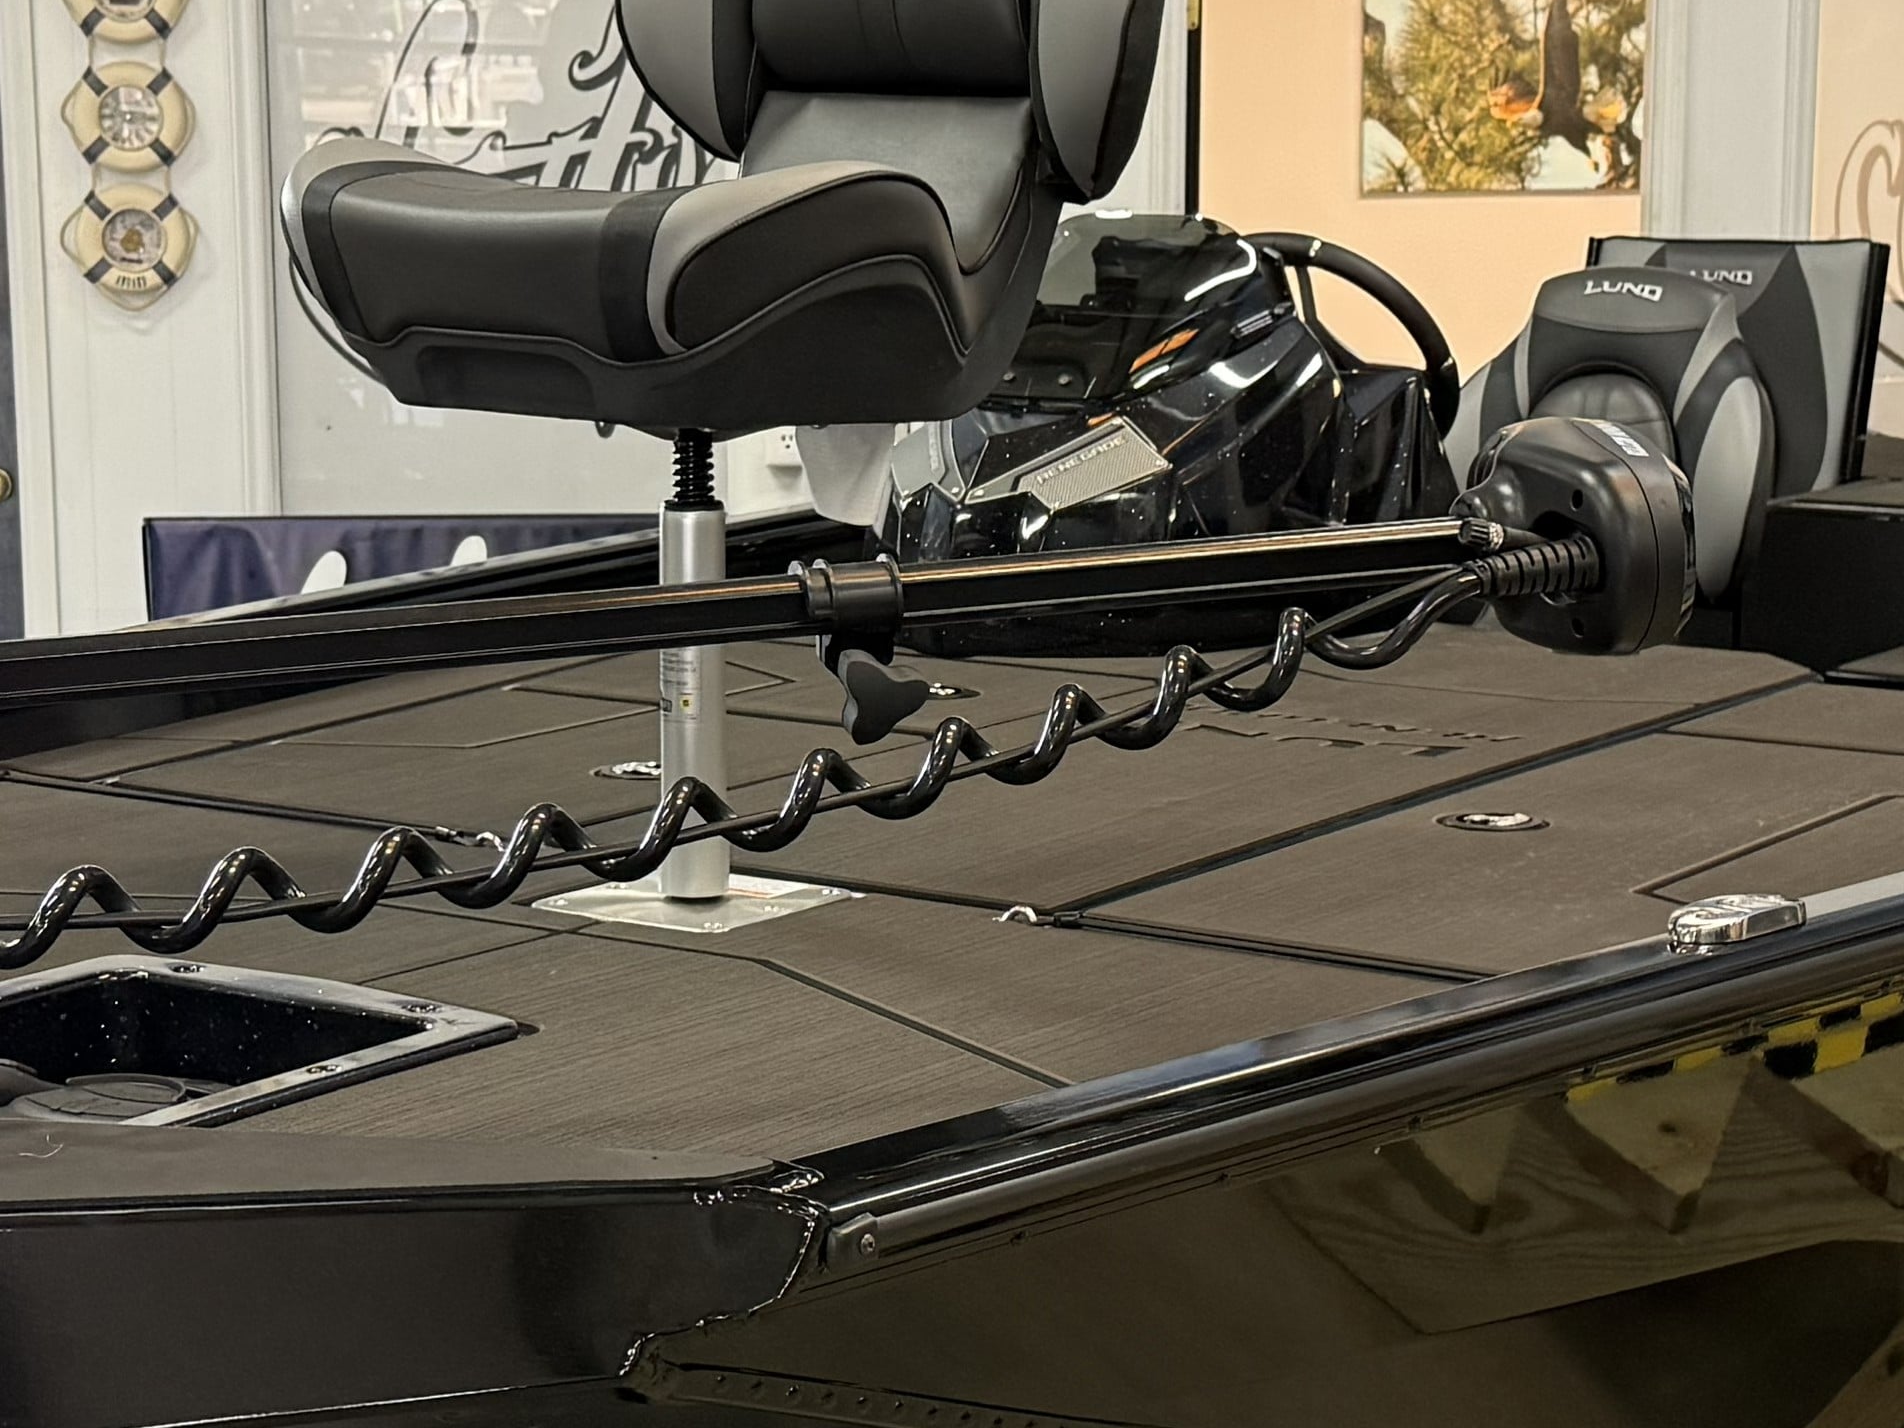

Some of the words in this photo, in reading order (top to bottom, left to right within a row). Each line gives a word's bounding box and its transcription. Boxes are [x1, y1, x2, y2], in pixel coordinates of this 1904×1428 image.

[1690, 269, 1753, 285] UND
[1583, 280, 1664, 302] LUND
[1036, 434, 1129, 485] RENEGADE
